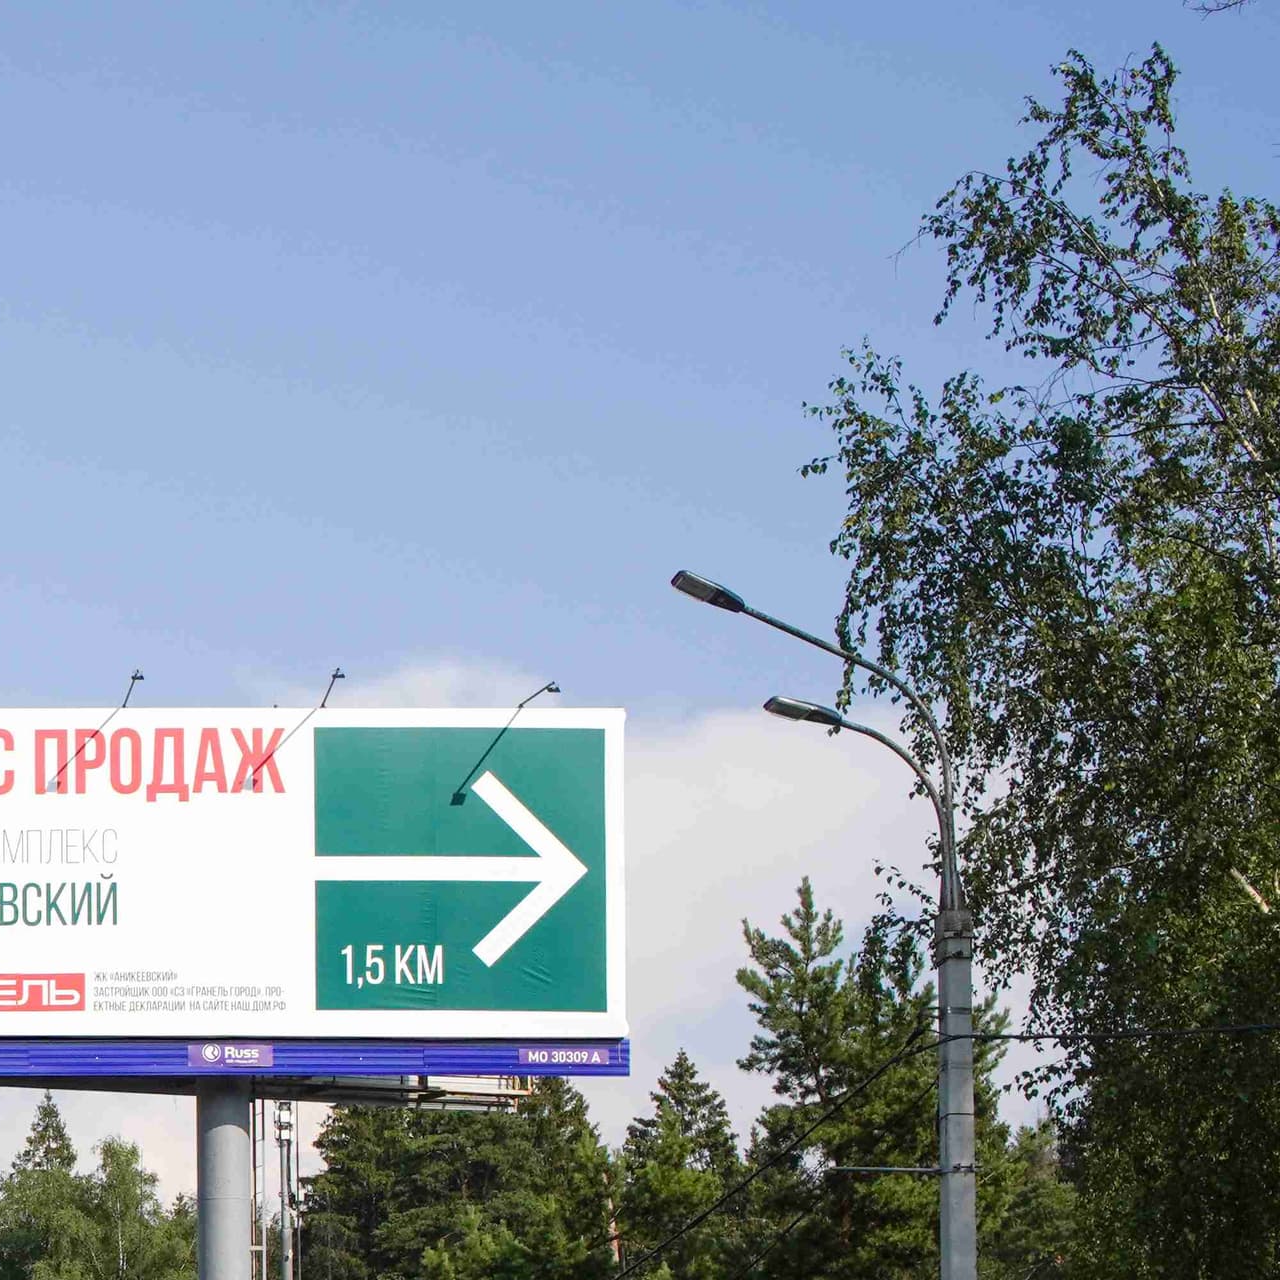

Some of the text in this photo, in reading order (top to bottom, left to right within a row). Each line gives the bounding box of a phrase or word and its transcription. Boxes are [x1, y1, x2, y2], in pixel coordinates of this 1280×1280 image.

[34, 727, 286, 802] ПРОДАЖ
[341, 944, 444, 989] 1,5 КМ
[94, 971, 108, 982] ЖК
[93, 985, 150, 998] ЗАСТРОЙЩИК
[224, 1046, 259, 1059] Russ
[552, 1051, 588, 1064] 30309
